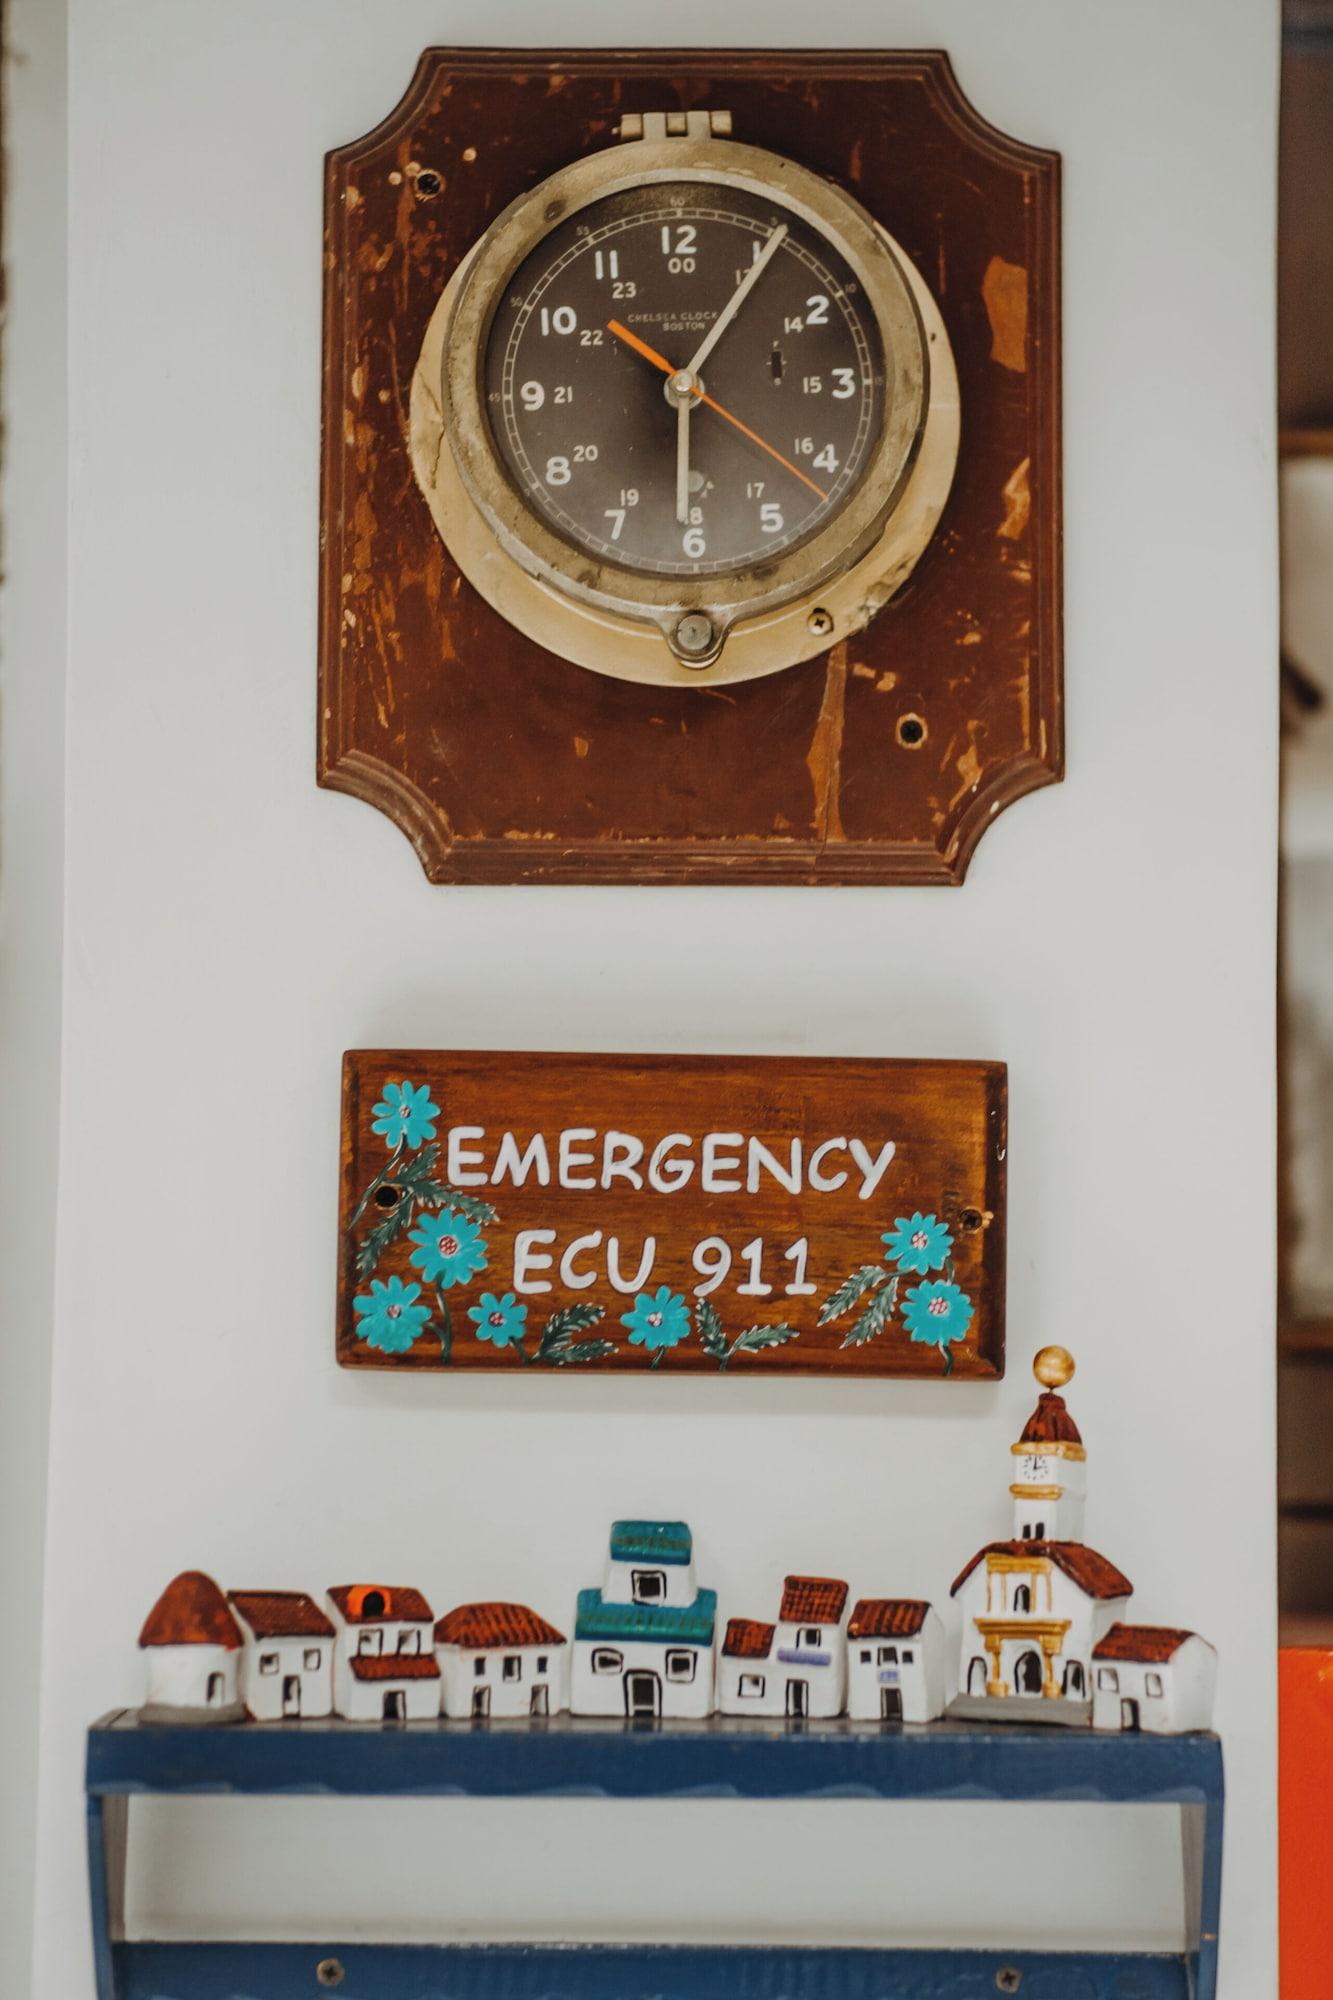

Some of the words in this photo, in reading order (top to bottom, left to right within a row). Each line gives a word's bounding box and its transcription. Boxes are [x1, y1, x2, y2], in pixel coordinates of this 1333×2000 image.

[661, 224, 697, 254] 12
[595, 250, 619, 280] 11
[668, 257, 696, 274] 00
[753, 240, 762, 268] 1
[736, 269, 752, 286] 1
[612, 281, 637, 299] 23
[627, 313, 677, 323] CHELSEA
[680, 311, 718, 320] CLOCK
[806, 295, 829, 324] 2
[541, 306, 577, 337] 10
[662, 322, 705, 331] BOSTON
[784, 317, 804, 334] 14
[580, 330, 604, 346] 22
[553, 386, 573, 404] 21
[803, 376, 822, 394] 15
[831, 368, 856, 399] 3
[520, 381, 545, 411] 9
[573, 445, 599, 462] 20
[794, 437, 814, 455] 16
[813, 444, 839, 473] 4
[546, 456, 571, 485] 8
[620, 488, 639, 506] 19
[747, 482, 765, 498] 17
[604, 509, 626, 540] 7
[685, 506, 703, 525] 8
[760, 503, 784, 533] 5
[683, 528, 706, 558] 6
[447, 1126, 896, 1200] EMERGENCY
[512, 1229, 656, 1295] ECU
[691, 1236, 817, 1297] 911
